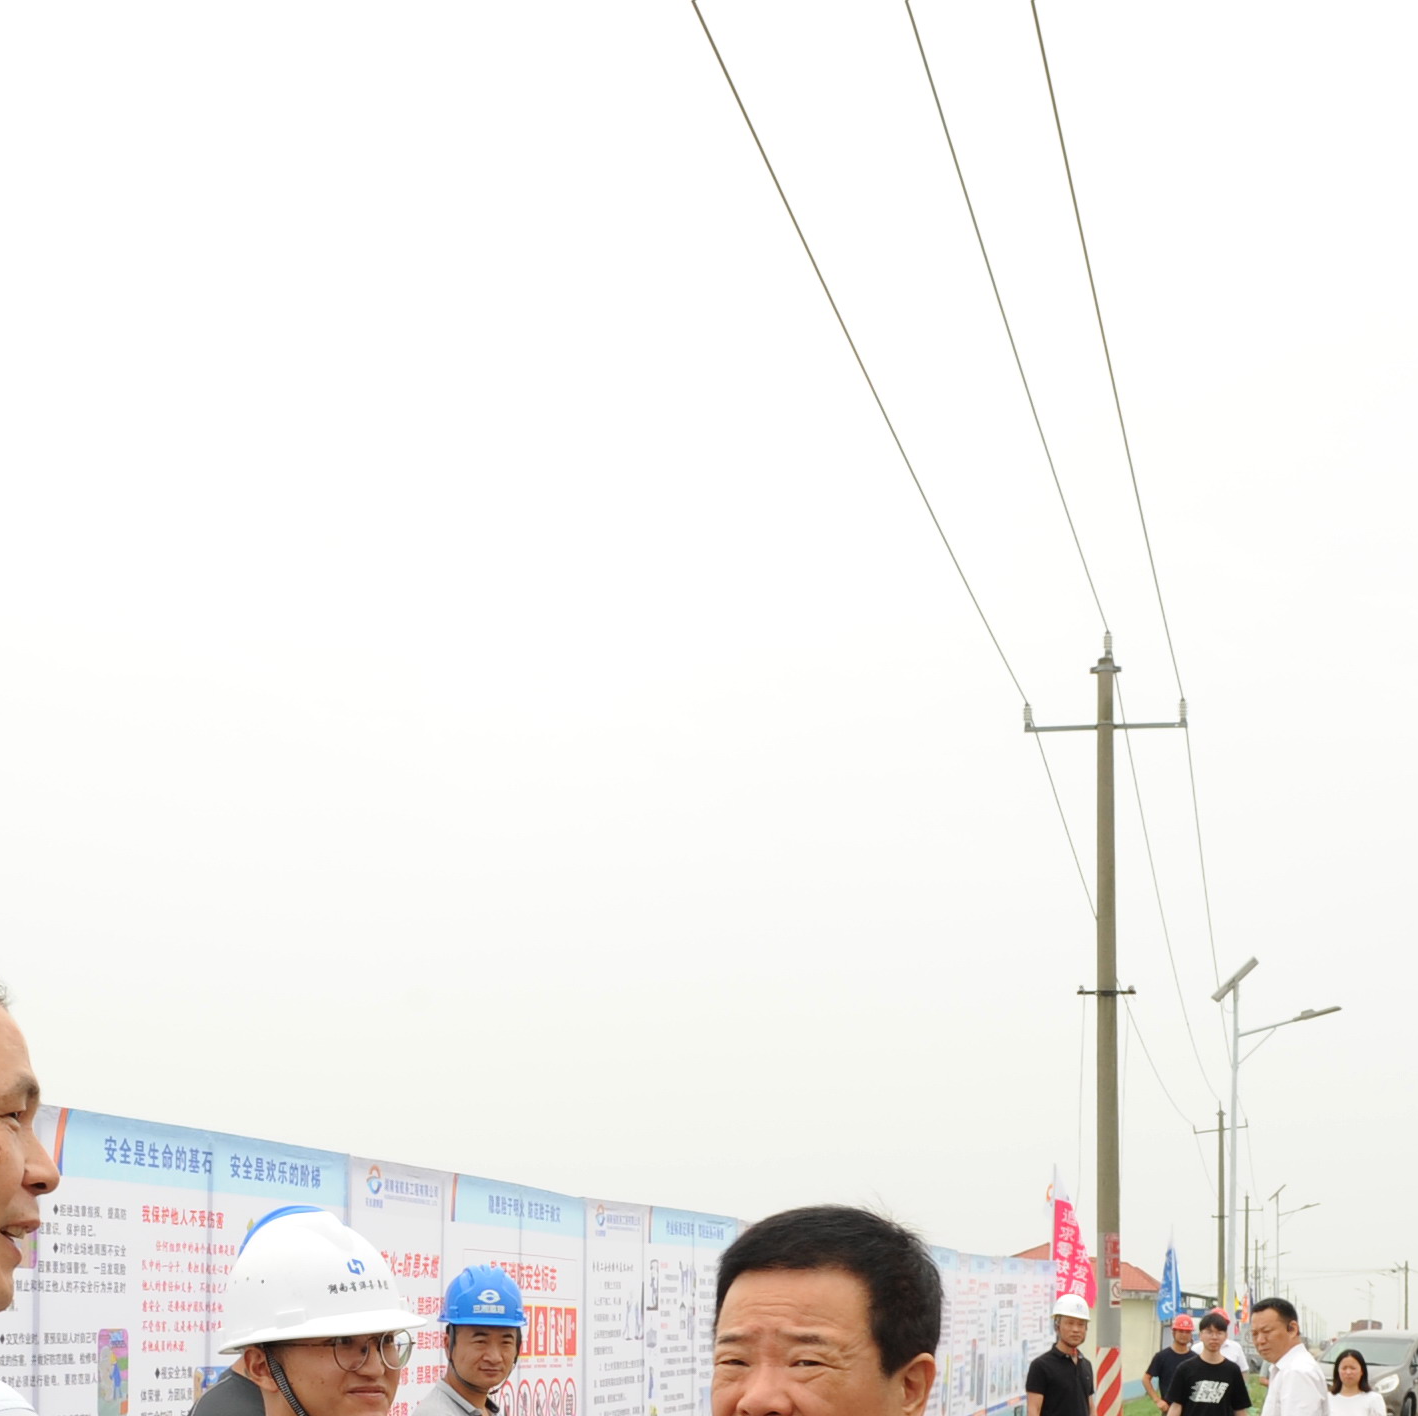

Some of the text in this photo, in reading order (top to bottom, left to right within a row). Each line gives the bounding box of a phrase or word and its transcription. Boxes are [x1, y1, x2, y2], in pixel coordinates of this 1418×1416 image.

[104, 1136, 321, 1189] 安全是生命的基石 安全是欢乐的阶梯
[142, 1205, 224, 1229] 我保护他人不受伤害
[490, 1260, 557, 1292] 消防安全标志
